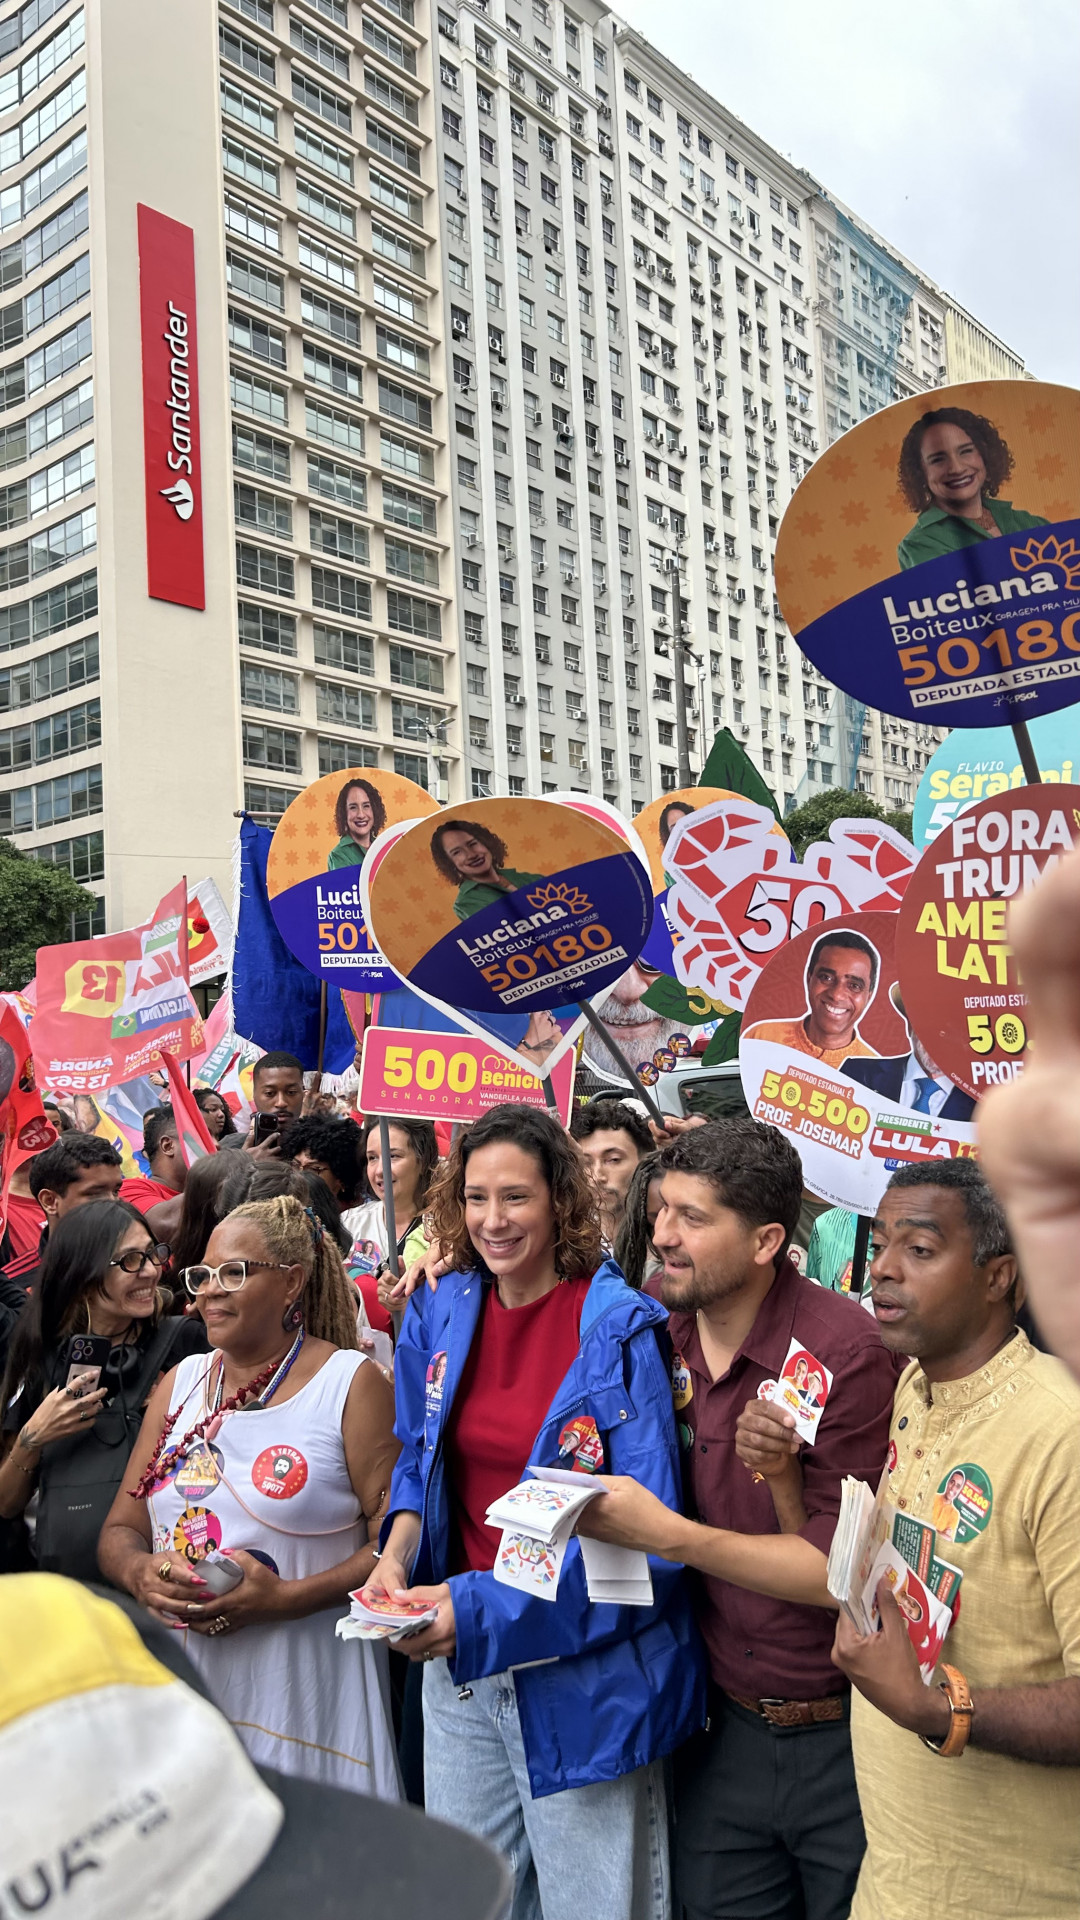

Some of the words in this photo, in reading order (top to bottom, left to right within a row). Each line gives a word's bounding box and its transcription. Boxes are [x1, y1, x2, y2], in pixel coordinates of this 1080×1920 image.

[164, 300, 192, 475] Santander
[882, 570, 1059, 625] Luciana
[891, 612, 995, 645] Boiteux
[1041, 601, 1060, 612] PRA
[915, 677, 1009, 703] DEPUTADA
[957, 761, 1004, 774] FLAVIO
[952, 809, 1075, 858] FORA
[935, 854, 1062, 899] TRUM
[316, 884, 360, 905] Luci
[456, 905, 569, 957] Luciana
[737, 880, 842, 953] 50
[318, 922, 374, 951] 501
[470, 936, 536, 968] Boiteux
[323, 956, 369, 965] DEPUTADA
[372, 956, 383, 965] ES
[480, 924, 613, 993] 50180
[937, 939, 1022, 985] LAT
[503, 975, 562, 1002] DEPUTADA
[563, 949, 624, 979] ESTADUAL
[964, 995, 1006, 1009] DEPUTADO
[383, 1045, 478, 1093] 500
[788, 1068, 818, 1085] DEPUTADO
[817, 1079, 845, 1097] ESTADUAL
[846, 1089, 852, 1099] É
[970, 1061, 1024, 1085] PROF
[381, 1090, 474, 1106] SENADORA
[480, 1092, 520, 1102] VANDERLEA
[522, 1096, 547, 1105] AGUIA
[762, 1072, 868, 1134] 50.500
[755, 1099, 793, 1128] PROF.
[795, 1118, 861, 1157] JOSEMAR
[877, 1114, 930, 1130] PRESIDENTE
[872, 1129, 952, 1159] LULA
[885, 1158, 897, 1167] VICE
